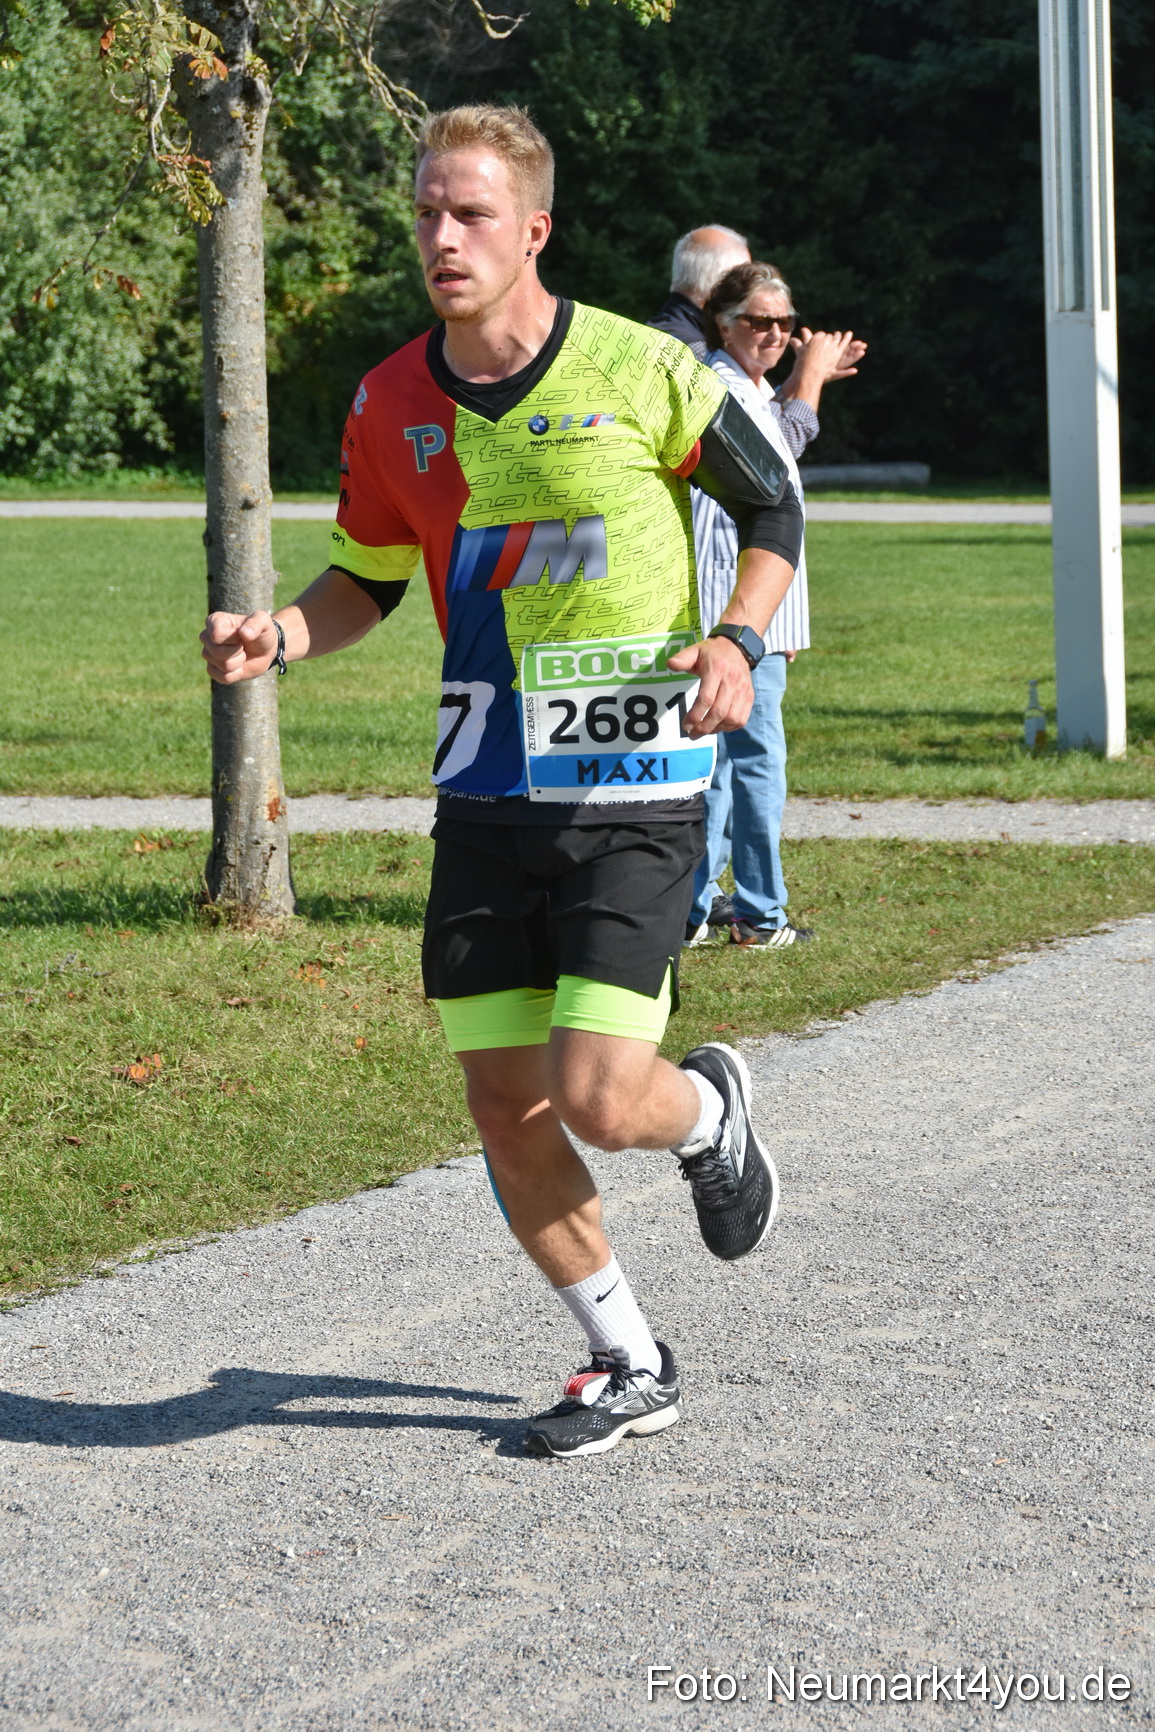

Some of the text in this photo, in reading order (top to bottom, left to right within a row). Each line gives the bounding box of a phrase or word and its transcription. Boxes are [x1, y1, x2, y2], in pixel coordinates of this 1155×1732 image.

[556, 435, 600, 446] NEUMARKT
[548, 691, 690, 744] 2681
[577, 757, 669, 784] MAXI
